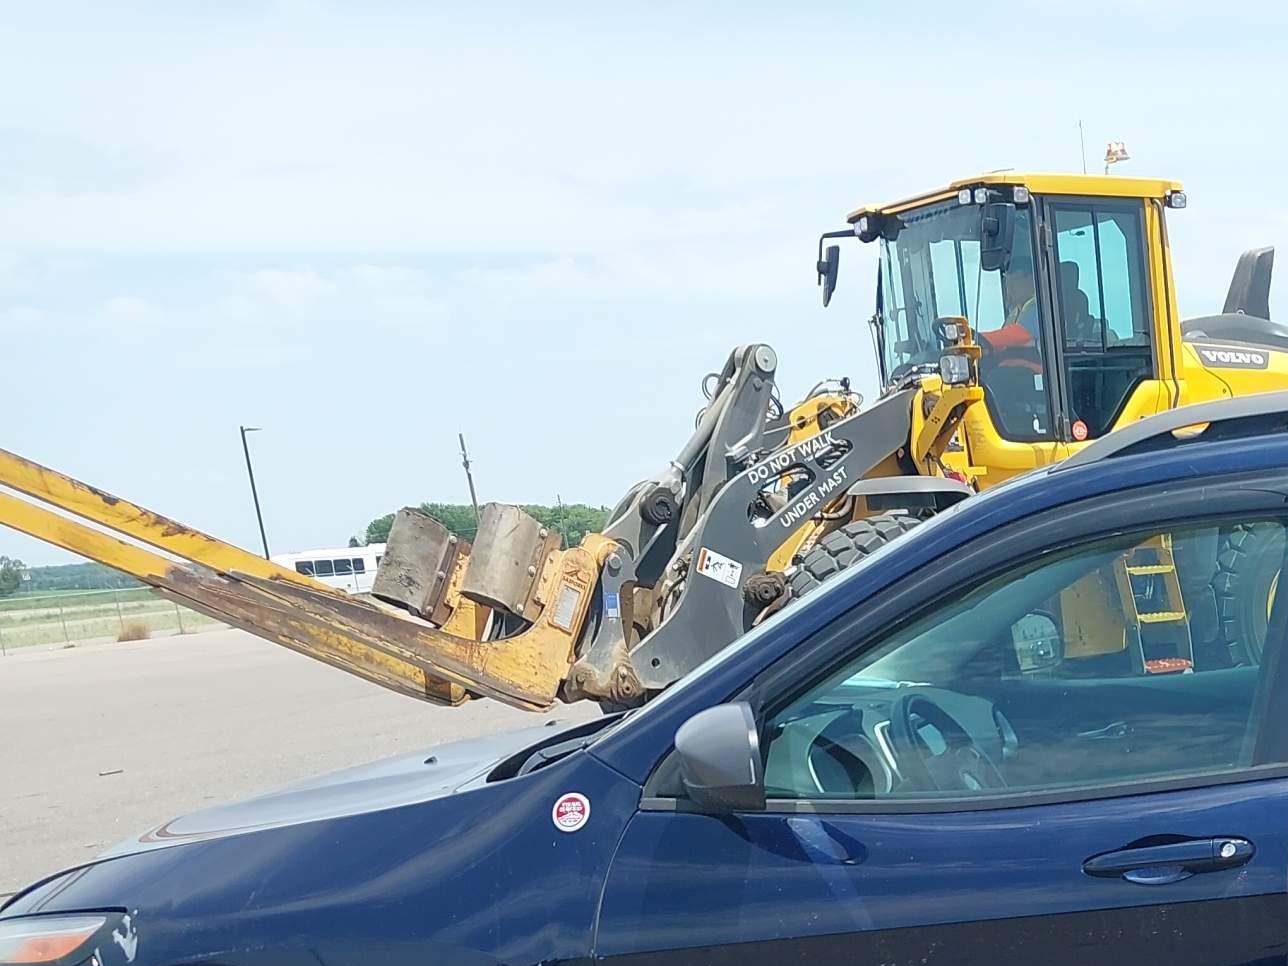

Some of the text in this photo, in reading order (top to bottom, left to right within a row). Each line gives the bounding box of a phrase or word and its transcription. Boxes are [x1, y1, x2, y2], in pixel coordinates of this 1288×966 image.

[1201, 350, 1264, 365] VOLVO
[748, 432, 835, 485] DO NOT WALK
[780, 466, 848, 527] UNDER MAST
